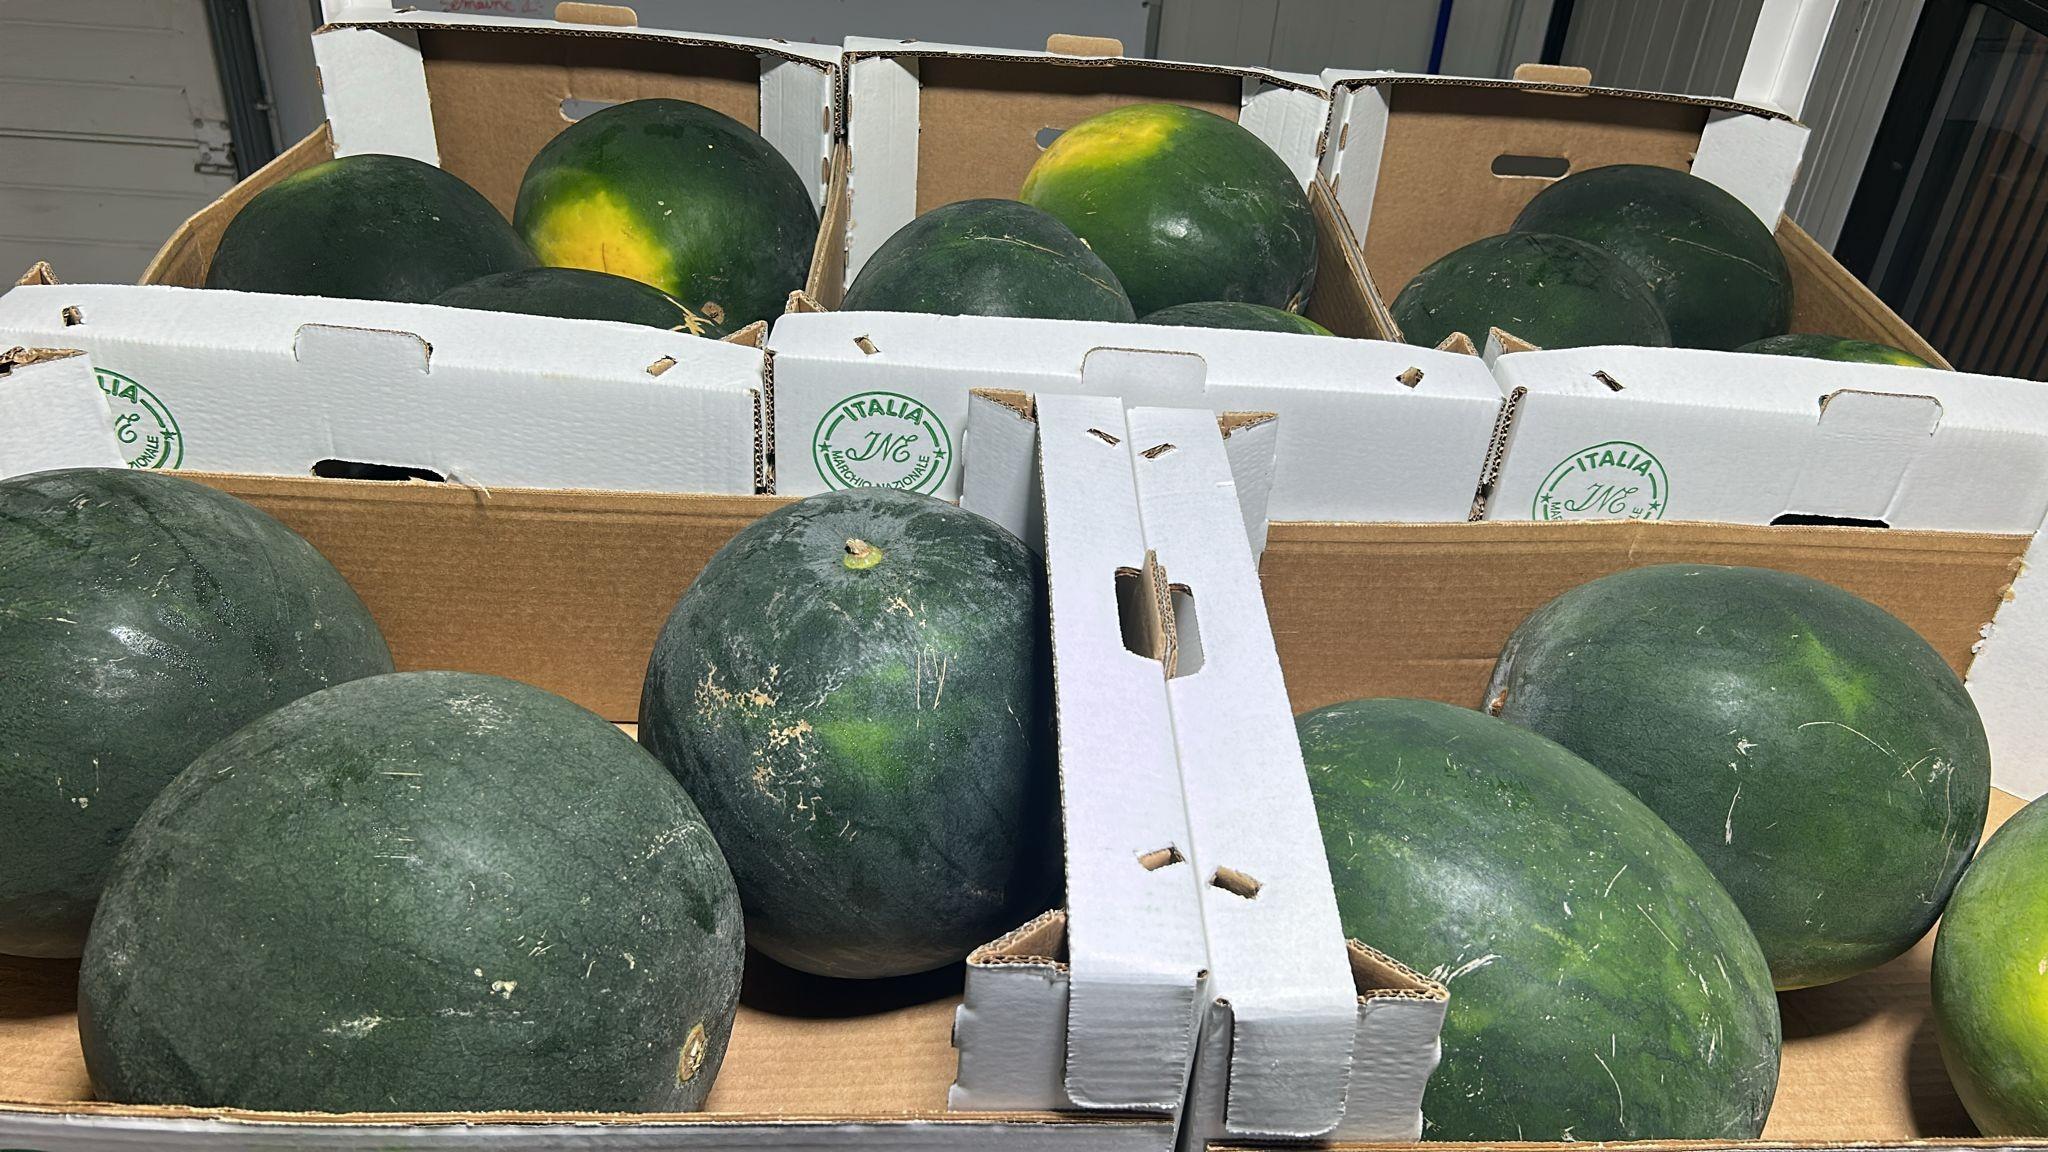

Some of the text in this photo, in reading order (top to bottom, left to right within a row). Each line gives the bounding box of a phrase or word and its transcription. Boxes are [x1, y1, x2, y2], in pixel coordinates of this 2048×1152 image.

[97, 375, 137, 403] LIA
[843, 398, 923, 425] ITALIA
[832, 451, 872, 487] MARCHIO
[1576, 450, 1651, 476] ITALIA
